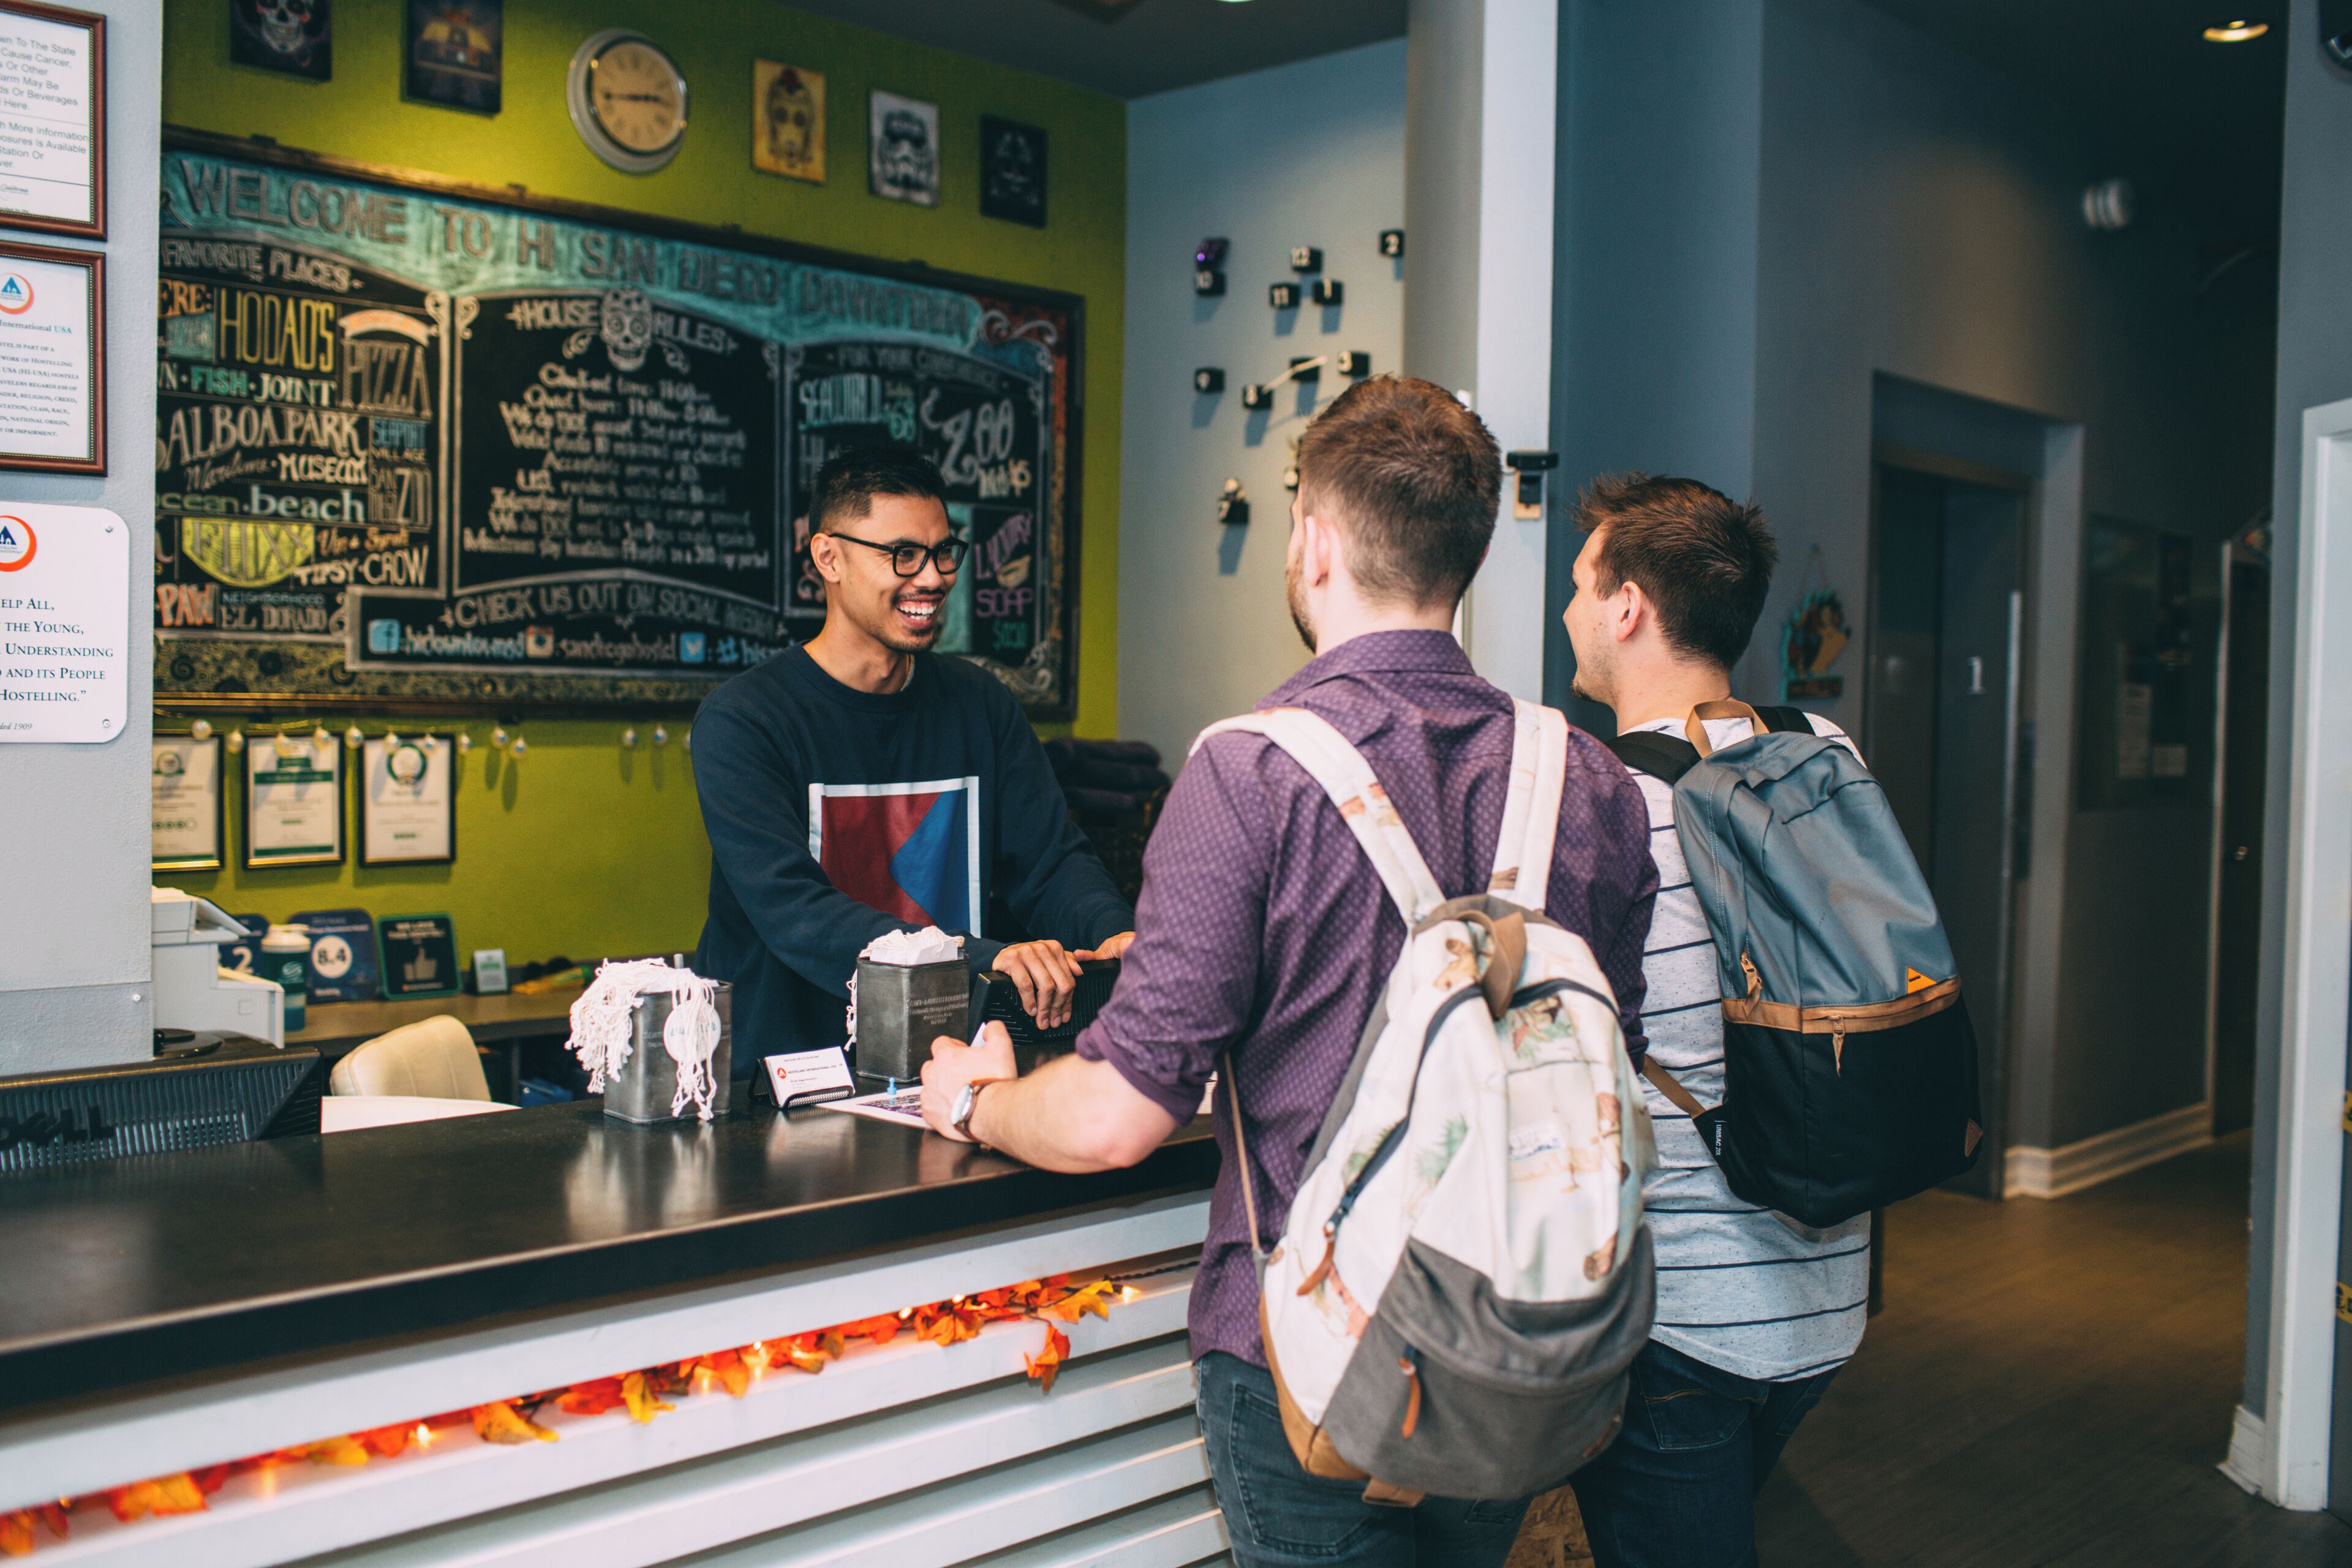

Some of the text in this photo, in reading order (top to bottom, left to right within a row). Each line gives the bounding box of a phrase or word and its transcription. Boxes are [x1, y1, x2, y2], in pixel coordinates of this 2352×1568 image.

[15, 37, 27, 47] To
[29, 39, 48, 51] The
[51, 43, 76, 56] State
[6, 61, 48, 75] Or Other
[35, 53, 72, 68] Cancer.
[23, 77, 43, 89] May
[46, 80, 59, 90] Be
[12, 87, 24, 96] Or
[27, 89, 78, 105] Beverages
[9, 121, 89, 141] More Information
[32, 150, 44, 159] Or
[46, 140, 86, 154] Available
[181, 157, 971, 341] WELCOME TO HI SAN DIEGO DOWNTOWN
[1385, 233, 1400, 254] 2
[160, 239, 352, 293] FAVORITE PLACES
[1273, 287, 1289, 306] 11
[1323, 277, 1332, 298] 1
[54, 325, 72, 334] USA
[522, 299, 726, 354] HOUSE RULES
[18, 369, 50, 378] (HI-USA)
[190, 365, 247, 397] FISH
[341, 339, 432, 418] PIZZA
[29, 382, 67, 391] REGARDLESS
[254, 372, 337, 406] JOINT
[20, 393, 53, 402] RELIGION,
[55, 396, 78, 404] CREED,
[280, 405, 369, 459] PARK
[250, 483, 364, 524] beach
[293, 557, 360, 586] TIPSY
[363, 545, 429, 586] CROW
[454, 587, 536, 628] CHECK
[539, 585, 573, 612] US
[577, 582, 621, 612] OUT
[221, 604, 257, 630] EL
[6, 643, 114, 658] UNDERSTANDING
[60, 667, 106, 680] PEOPLE
[1967, 656, 1985, 695] 1
[317, 948, 346, 967] 8.4
